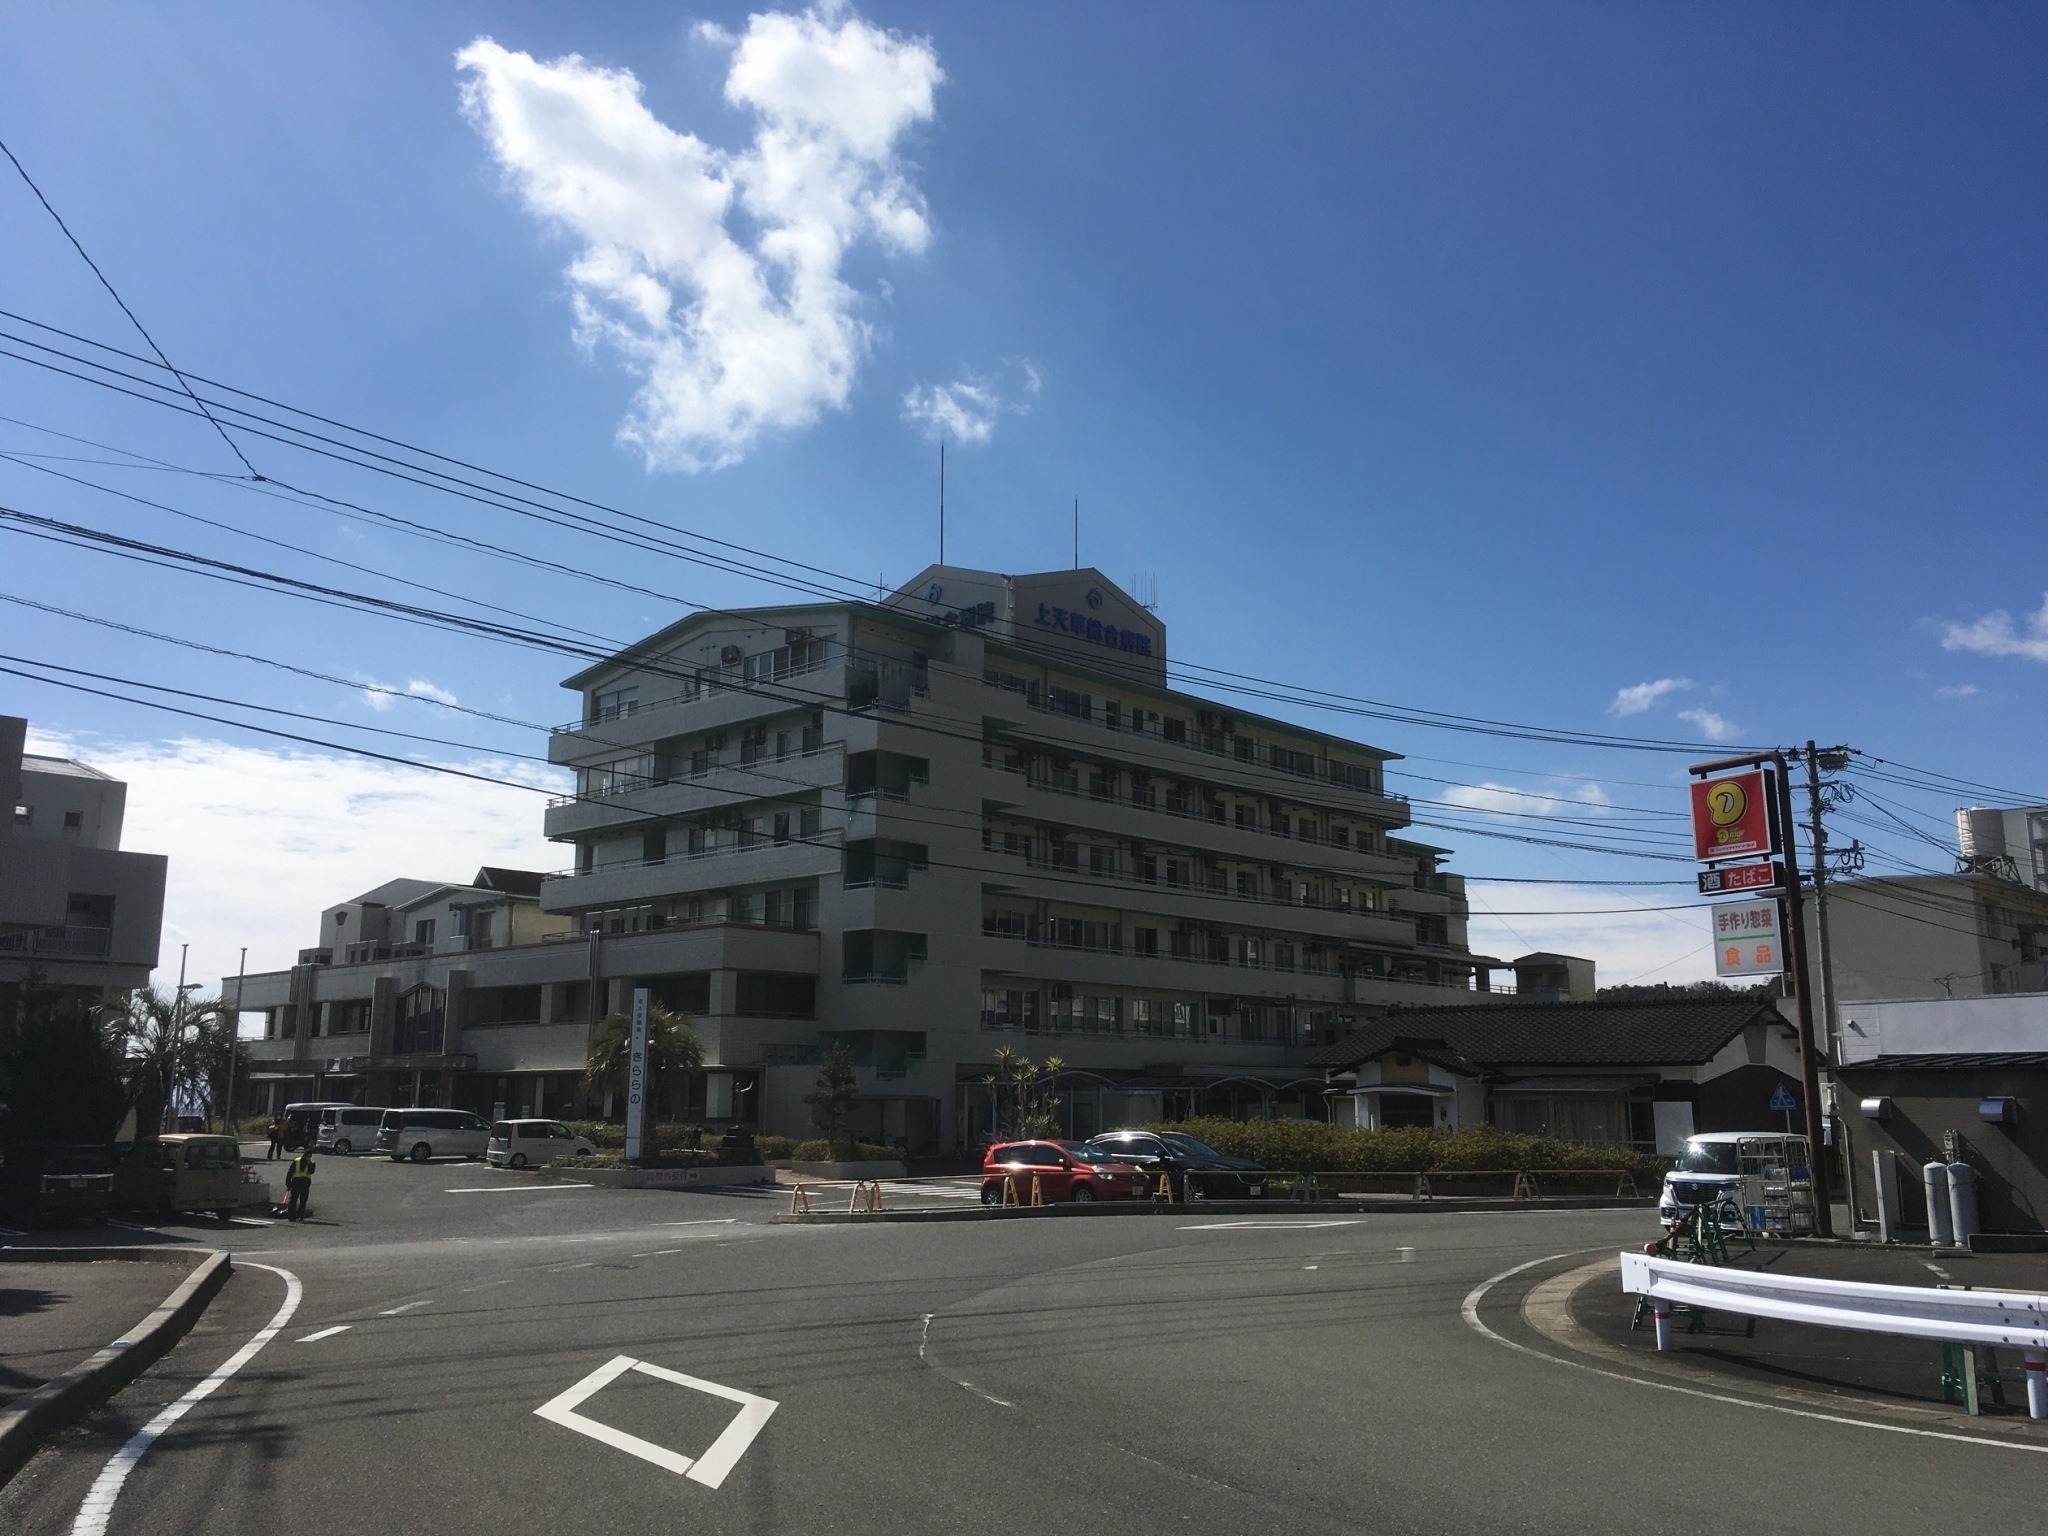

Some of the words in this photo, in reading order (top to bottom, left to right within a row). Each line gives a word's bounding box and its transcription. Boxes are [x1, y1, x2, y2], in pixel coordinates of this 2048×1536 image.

[1035, 602, 1152, 657] 上天草総合病院
[1702, 872, 1721, 891] 酒
[1728, 868, 1770, 887] たばこ
[1718, 909, 1773, 932] 手作り惣菜
